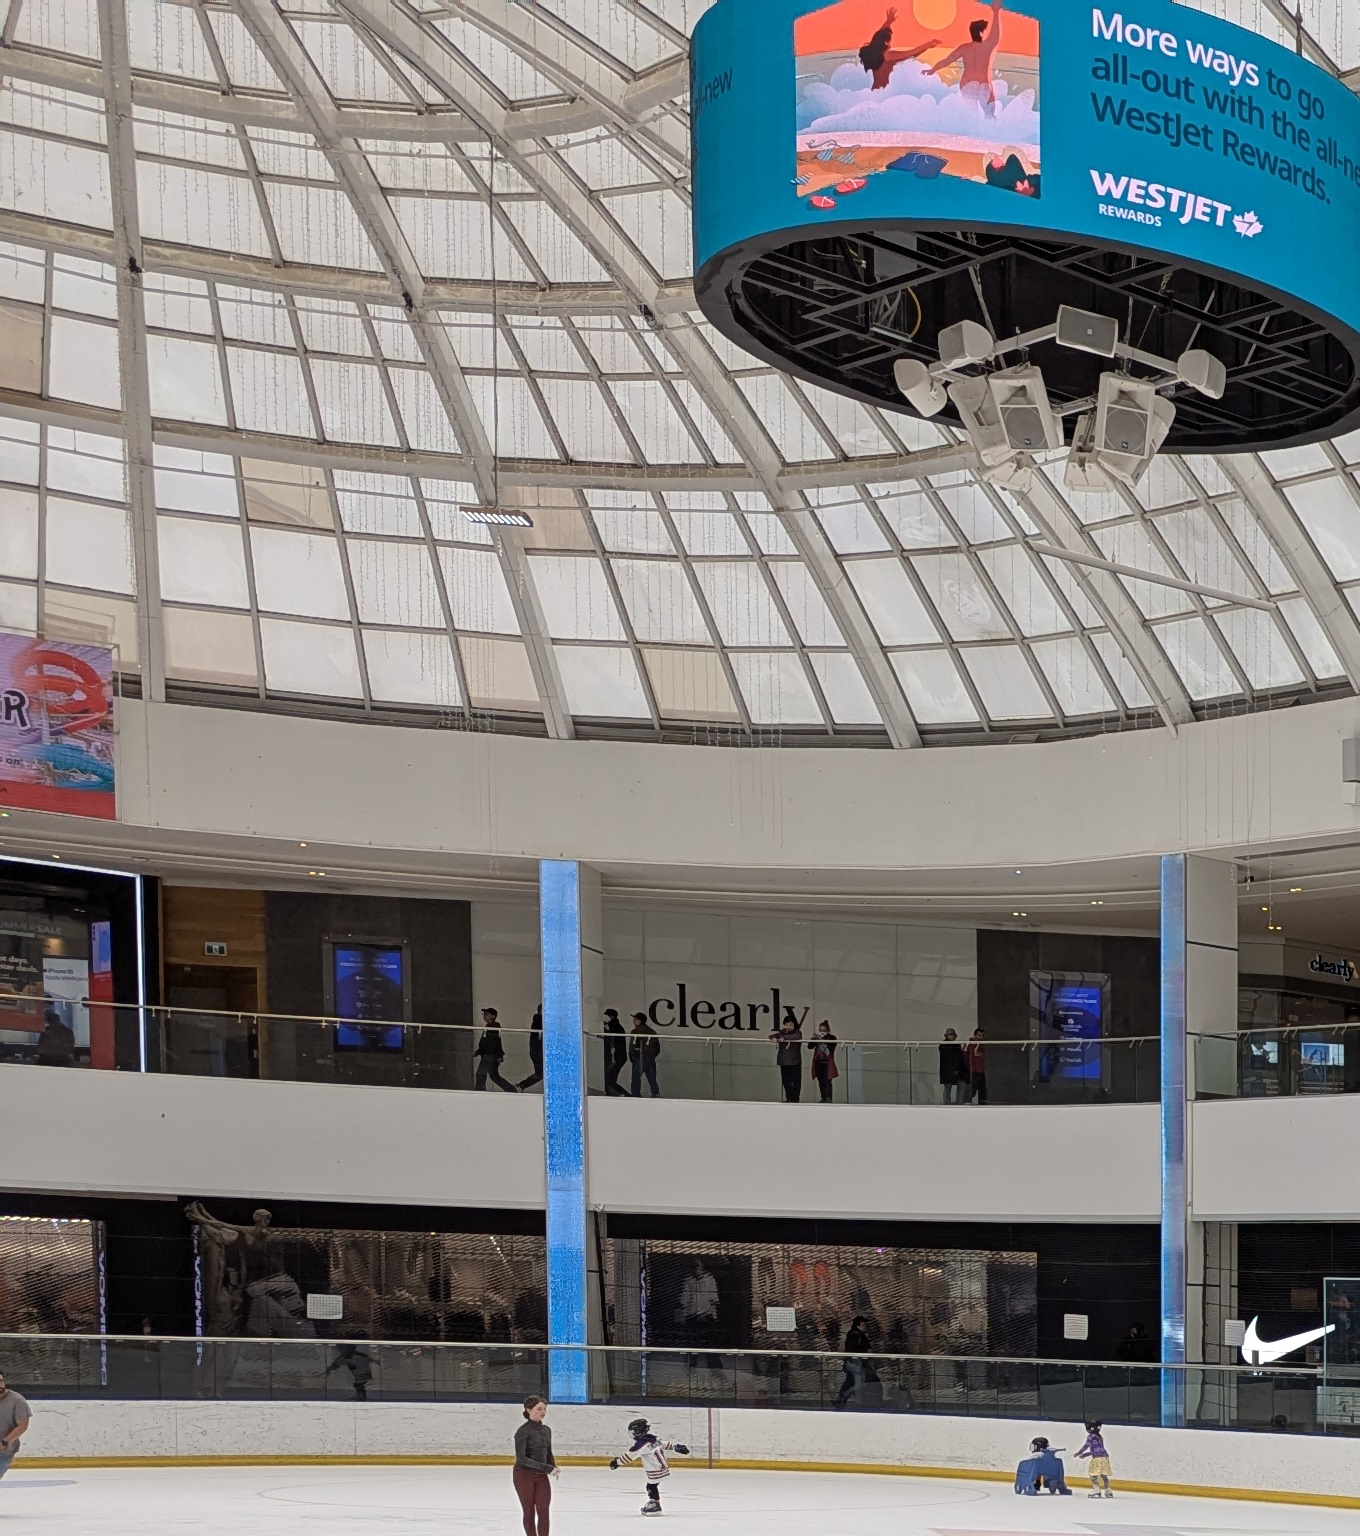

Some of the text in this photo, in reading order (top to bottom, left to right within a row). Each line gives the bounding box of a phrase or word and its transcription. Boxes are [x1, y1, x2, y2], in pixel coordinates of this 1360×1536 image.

[1091, 8, 1325, 121] More ways to go
[1091, 53, 1196, 104] all-out
[1201, 85, 1265, 130] with
[1271, 110, 1311, 152] the
[1090, 91, 1331, 205] WestJet Rewards.
[1089, 169, 1232, 226] WESTJET
[1098, 203, 1162, 227] REWARDS
[1310, 954, 1354, 982] clearly
[648, 983, 811, 1032] clearly
